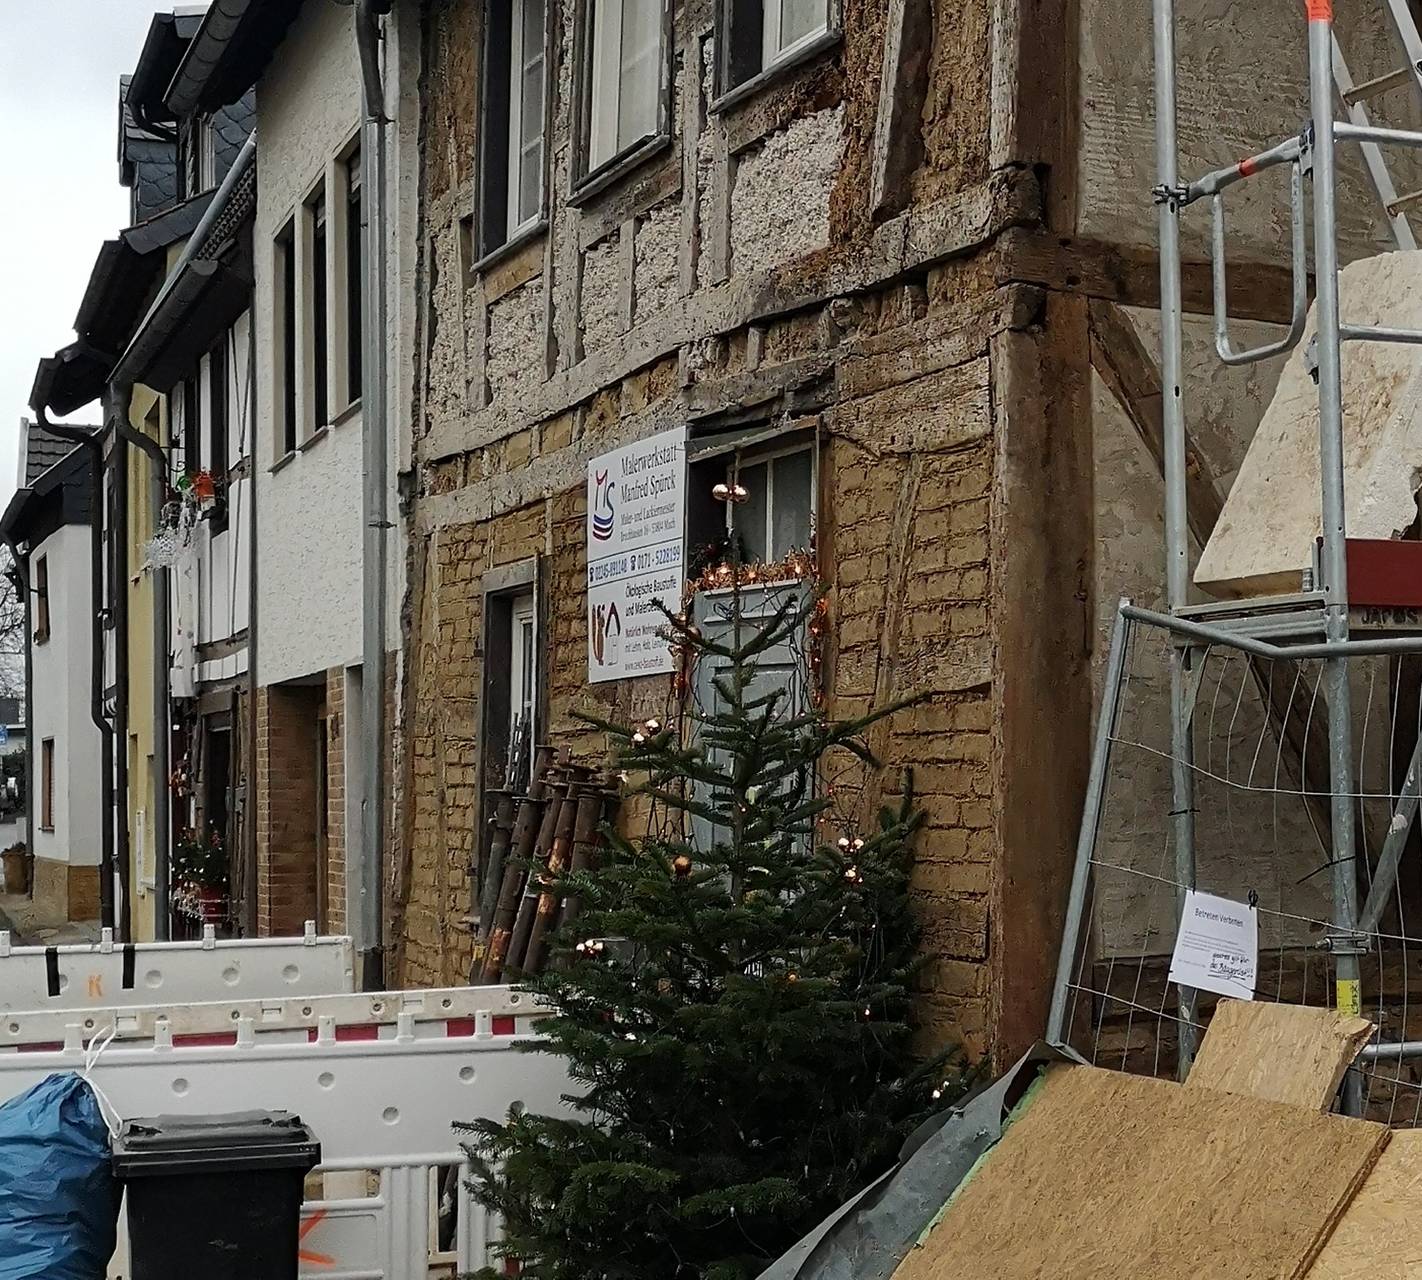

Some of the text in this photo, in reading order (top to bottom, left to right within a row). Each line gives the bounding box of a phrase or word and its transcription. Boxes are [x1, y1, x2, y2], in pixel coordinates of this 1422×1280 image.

[621, 442, 677, 478] Malerwerkstatt
[620, 468, 677, 504] Manfred Spürck
[625, 575, 677, 599] Ökologische Baustoffe
[1195, 907, 1244, 928] Betreten Verboten
